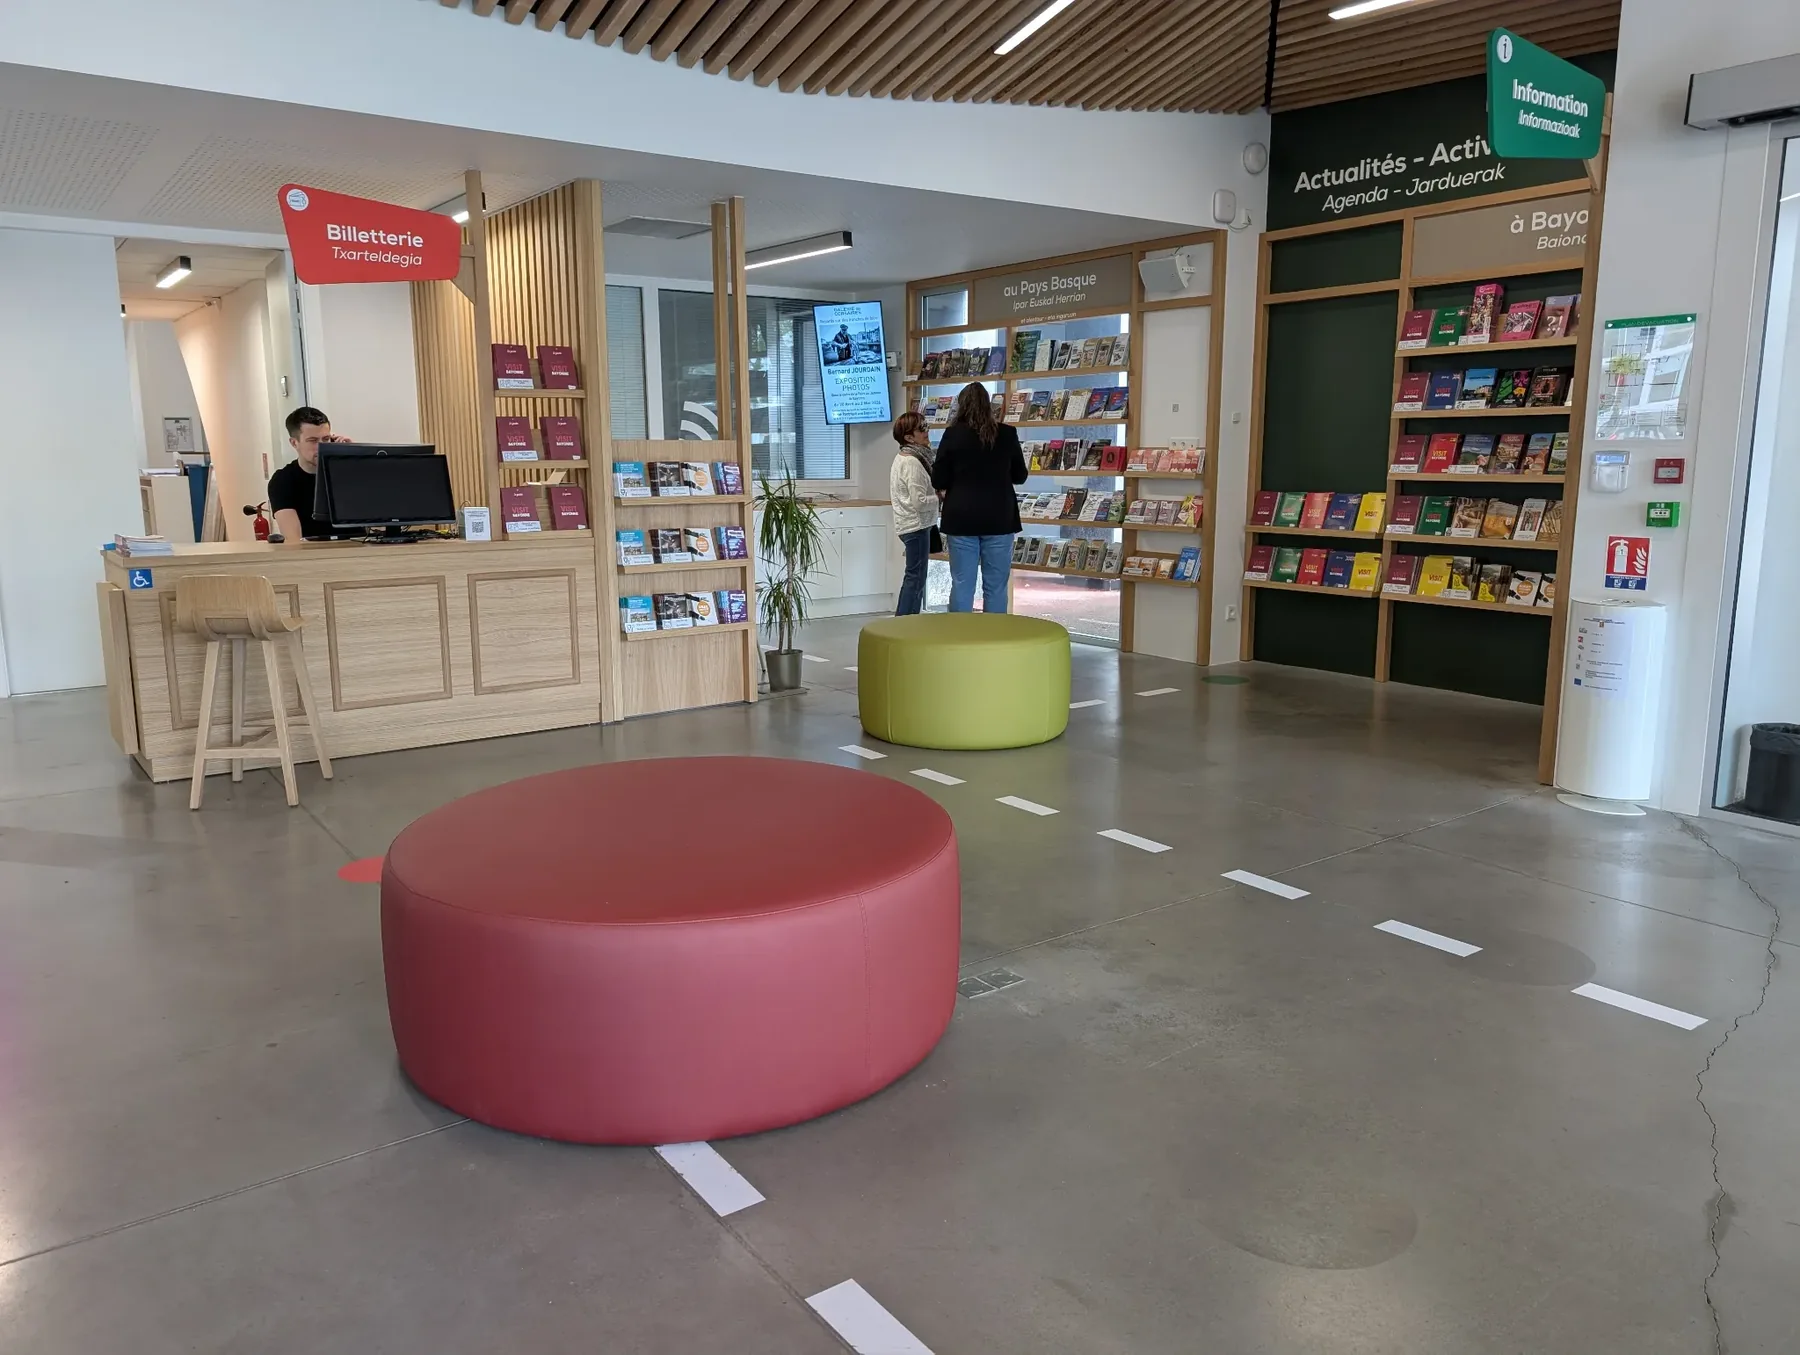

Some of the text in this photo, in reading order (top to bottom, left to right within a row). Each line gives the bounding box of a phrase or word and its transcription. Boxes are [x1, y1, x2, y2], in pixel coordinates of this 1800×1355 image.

[1512, 79, 1589, 117] Information
[1518, 110, 1580, 138] Informazioak
[1294, 153, 1407, 193] Actualités
[1322, 186, 1389, 214] Agenda
[1406, 162, 1506, 196] Jarduerak
[326, 223, 424, 248] Billetterie
[1510, 214, 1524, 234] à
[332, 246, 422, 268] Txarteldegia
[1003, 274, 1097, 297] au Pays Basque
[1029, 295, 1054, 308] Euskal
[835, 376, 876, 385] EXPOSITION
[851, 366, 881, 374] JOURDAIN
